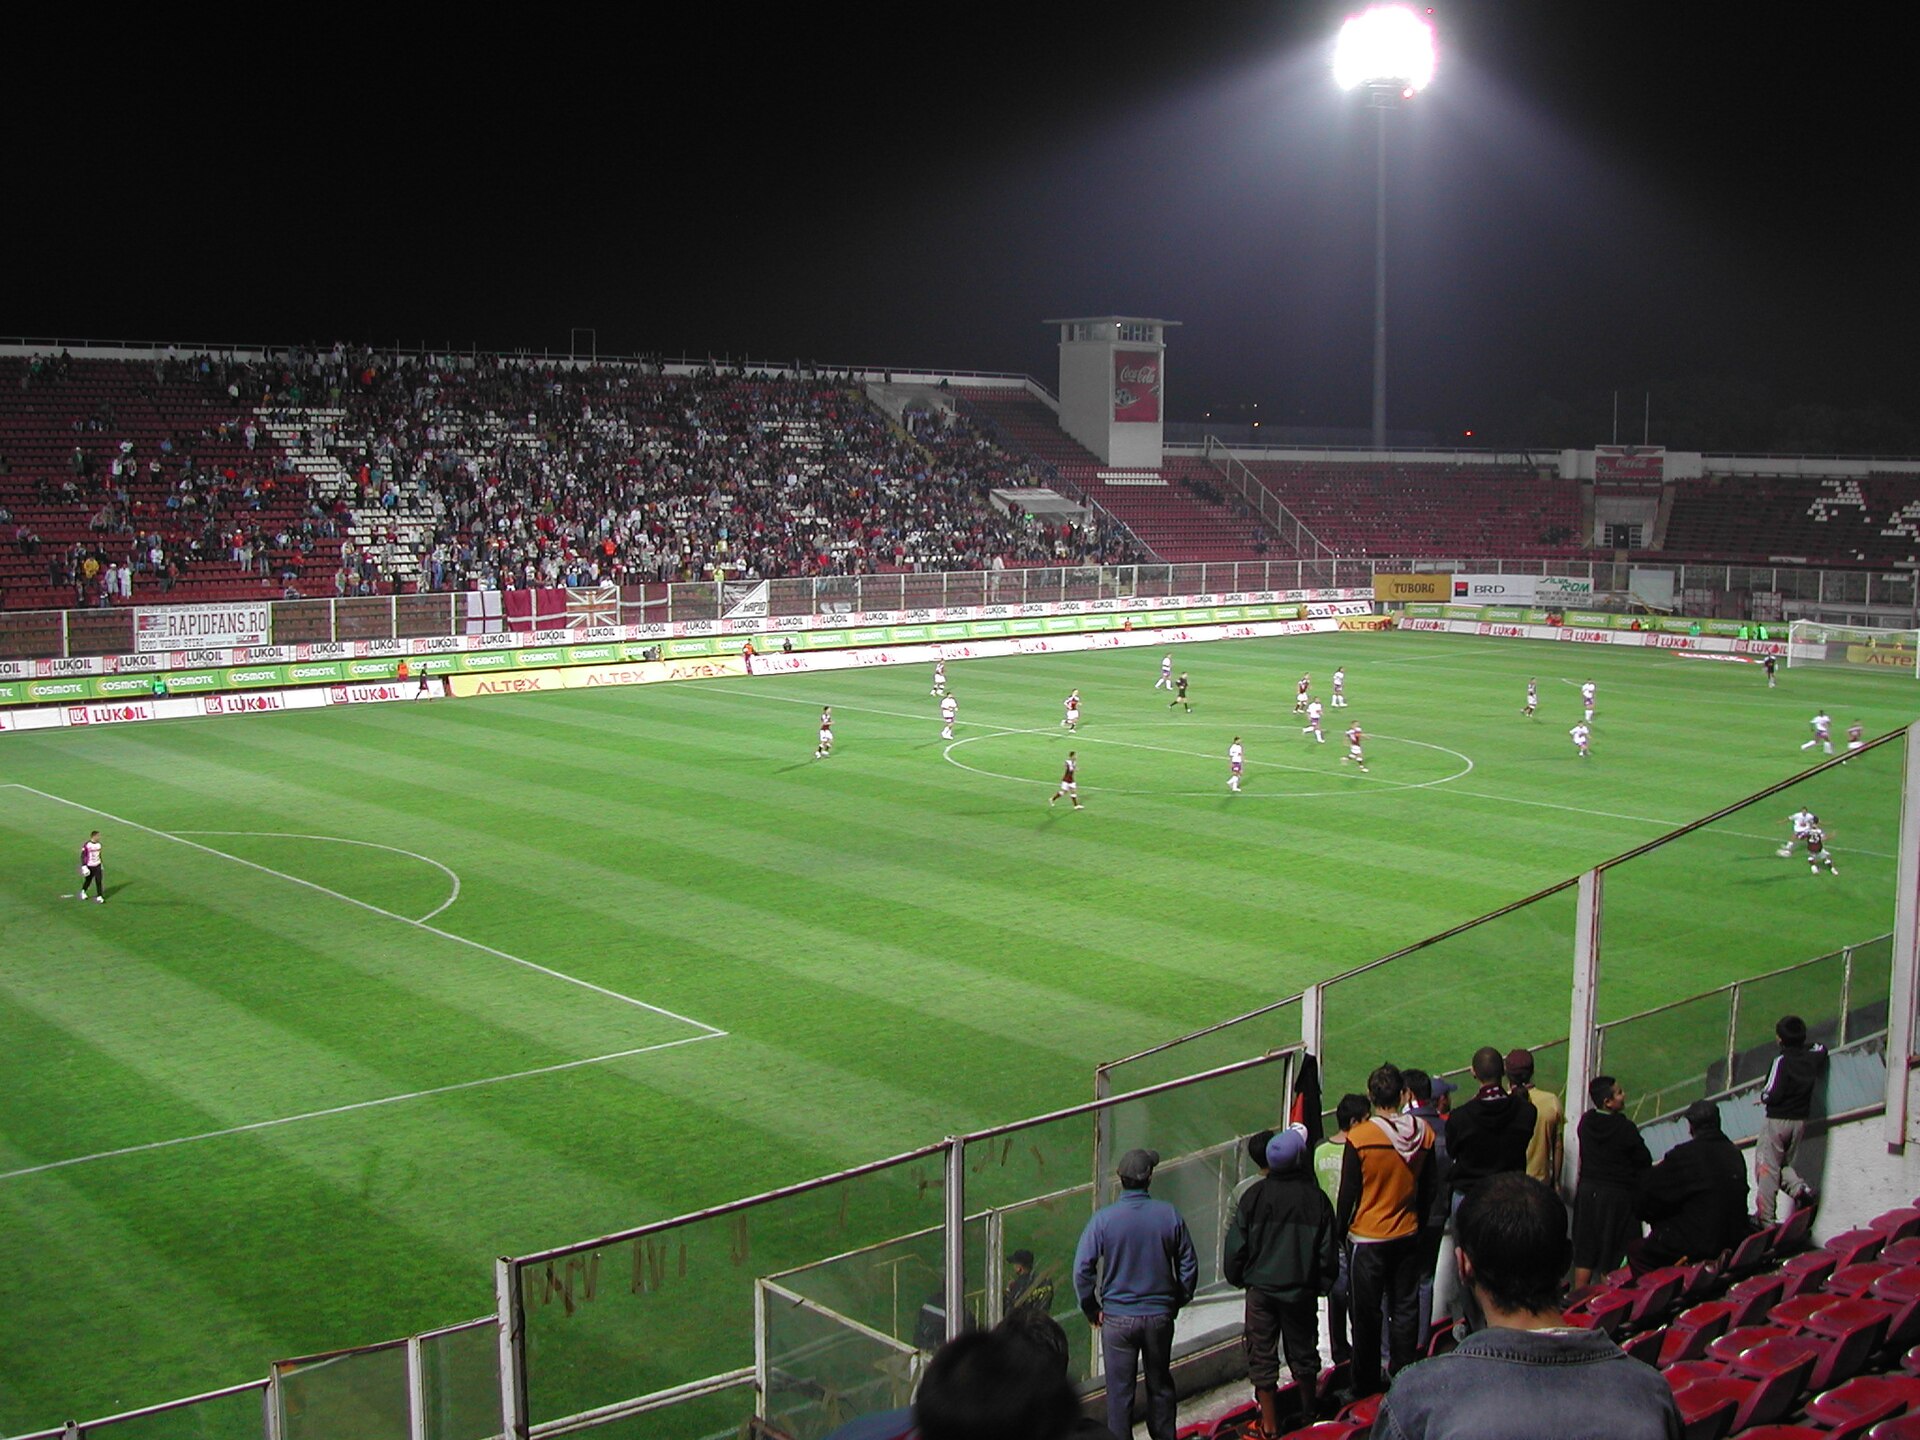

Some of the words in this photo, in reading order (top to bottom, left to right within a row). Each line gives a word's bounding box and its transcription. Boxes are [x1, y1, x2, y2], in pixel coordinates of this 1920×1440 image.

[1394, 583, 1435, 593] TUBORG
[1474, 585, 1505, 593] BRD
[907, 609, 930, 618] LUKOIL
[946, 607, 968, 616] LUKOIL
[986, 606, 1007, 614] LUKOIL
[1308, 604, 1366, 616] ADEPLAST
[778, 617, 803, 626] LUKOIL
[823, 614, 848, 623] LUKOIL
[865, 612, 889, 621] LUKOIL
[169, 611, 267, 636] RAPIDFANS.RO
[638, 623, 666, 633] LUKOIL
[686, 620, 713, 630] LUKOIL
[734, 619, 760, 629] LUKOIL
[1415, 620, 1444, 630] LUKOIL
[536, 630, 566, 640] LUKOIL
[587, 627, 615, 637] LUKOIL
[1493, 627, 1525, 636] LUKOIL
[1575, 632, 1608, 642] LUKOIL
[369, 638, 401, 650] LUKOIL
[427, 637, 459, 648] LUKOIL
[482, 634, 512, 644] LUKOIL
[1661, 638, 1696, 649] LUKOIL
[249, 647, 283, 658] LUKOIL
[311, 642, 345, 653] LUKOIL
[1751, 643, 1788, 654] LUKOIL
[120, 654, 156, 667] LUKOIL
[187, 651, 223, 662] LUKOIL
[53, 659, 92, 671] LUKOIL
[232, 671, 276, 681] COSMOTE
[294, 666, 336, 677] COSMOTE
[670, 664, 725, 678] ALTEX
[168, 674, 213, 686] COSMOTE
[587, 671, 644, 685] ALTEX
[33, 684, 83, 695] COSMOTE
[101, 679, 149, 690] COSMOTE
[477, 678, 541, 694] ALTEX
[352, 687, 399, 700] LUKOIL
[228, 697, 279, 711] LUKOIL
[94, 706, 147, 721] LUKOIL
